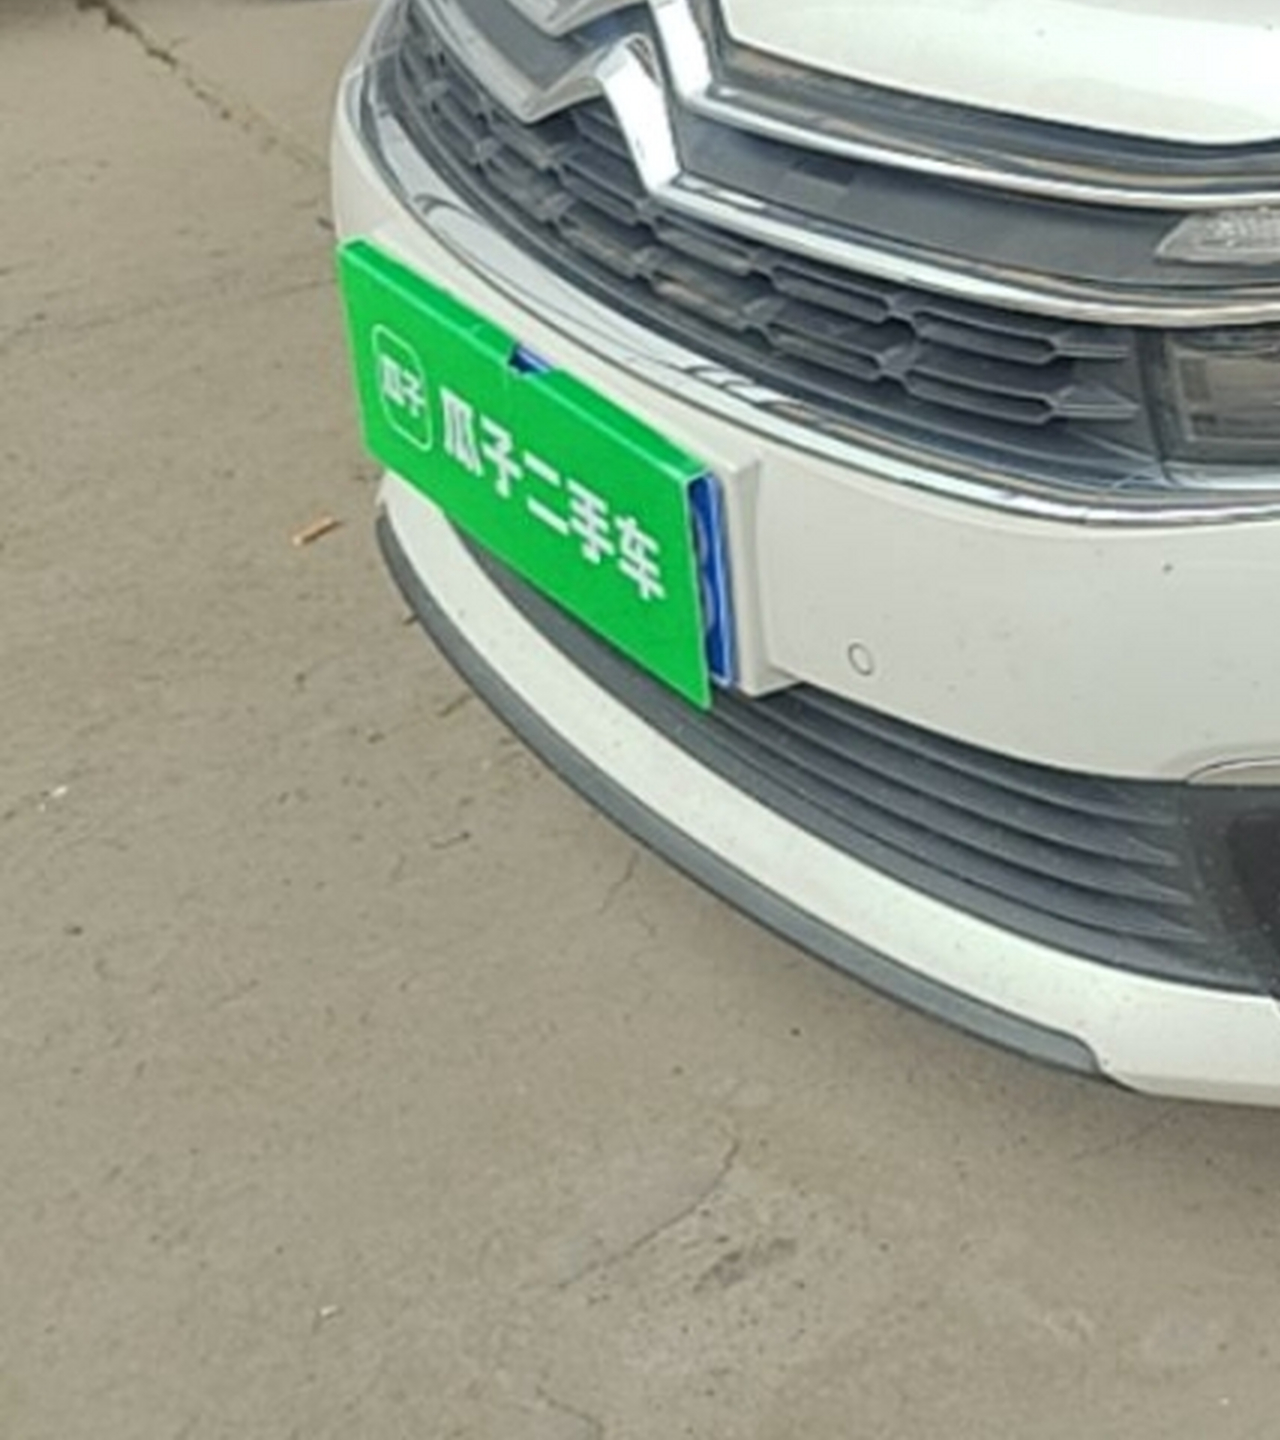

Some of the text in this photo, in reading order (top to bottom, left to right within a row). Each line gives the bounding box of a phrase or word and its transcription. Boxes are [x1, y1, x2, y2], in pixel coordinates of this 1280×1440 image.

[439, 385, 666, 601] 瓜子二手车
